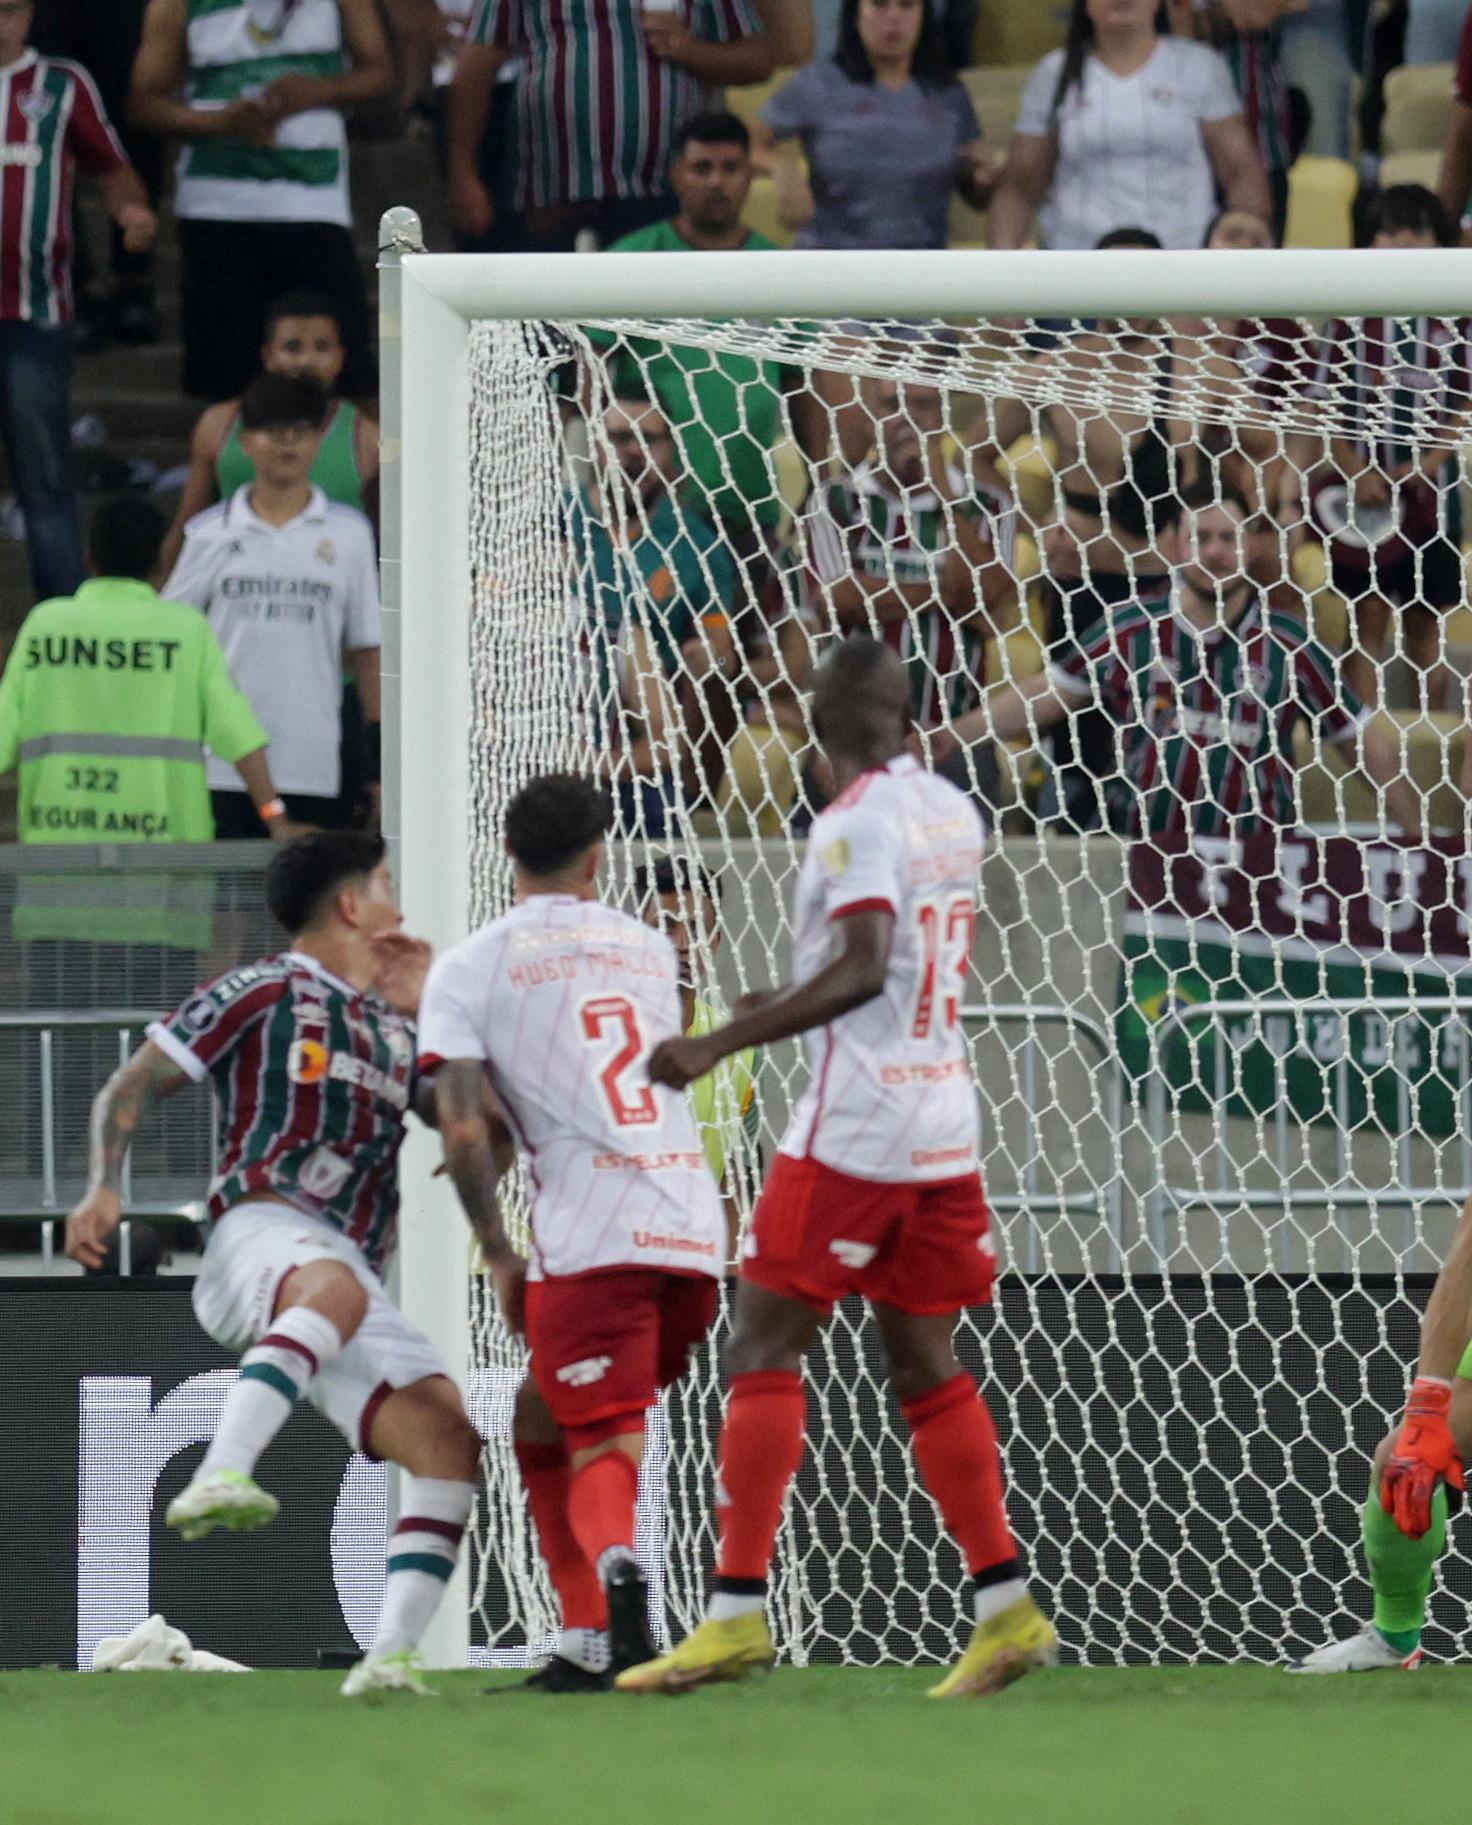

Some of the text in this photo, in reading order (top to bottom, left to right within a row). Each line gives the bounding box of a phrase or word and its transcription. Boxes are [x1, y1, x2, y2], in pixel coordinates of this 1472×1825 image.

[26, 636, 181, 672] SUNSET
[912, 899, 977, 1038] 13
[580, 996, 659, 1127] 2
